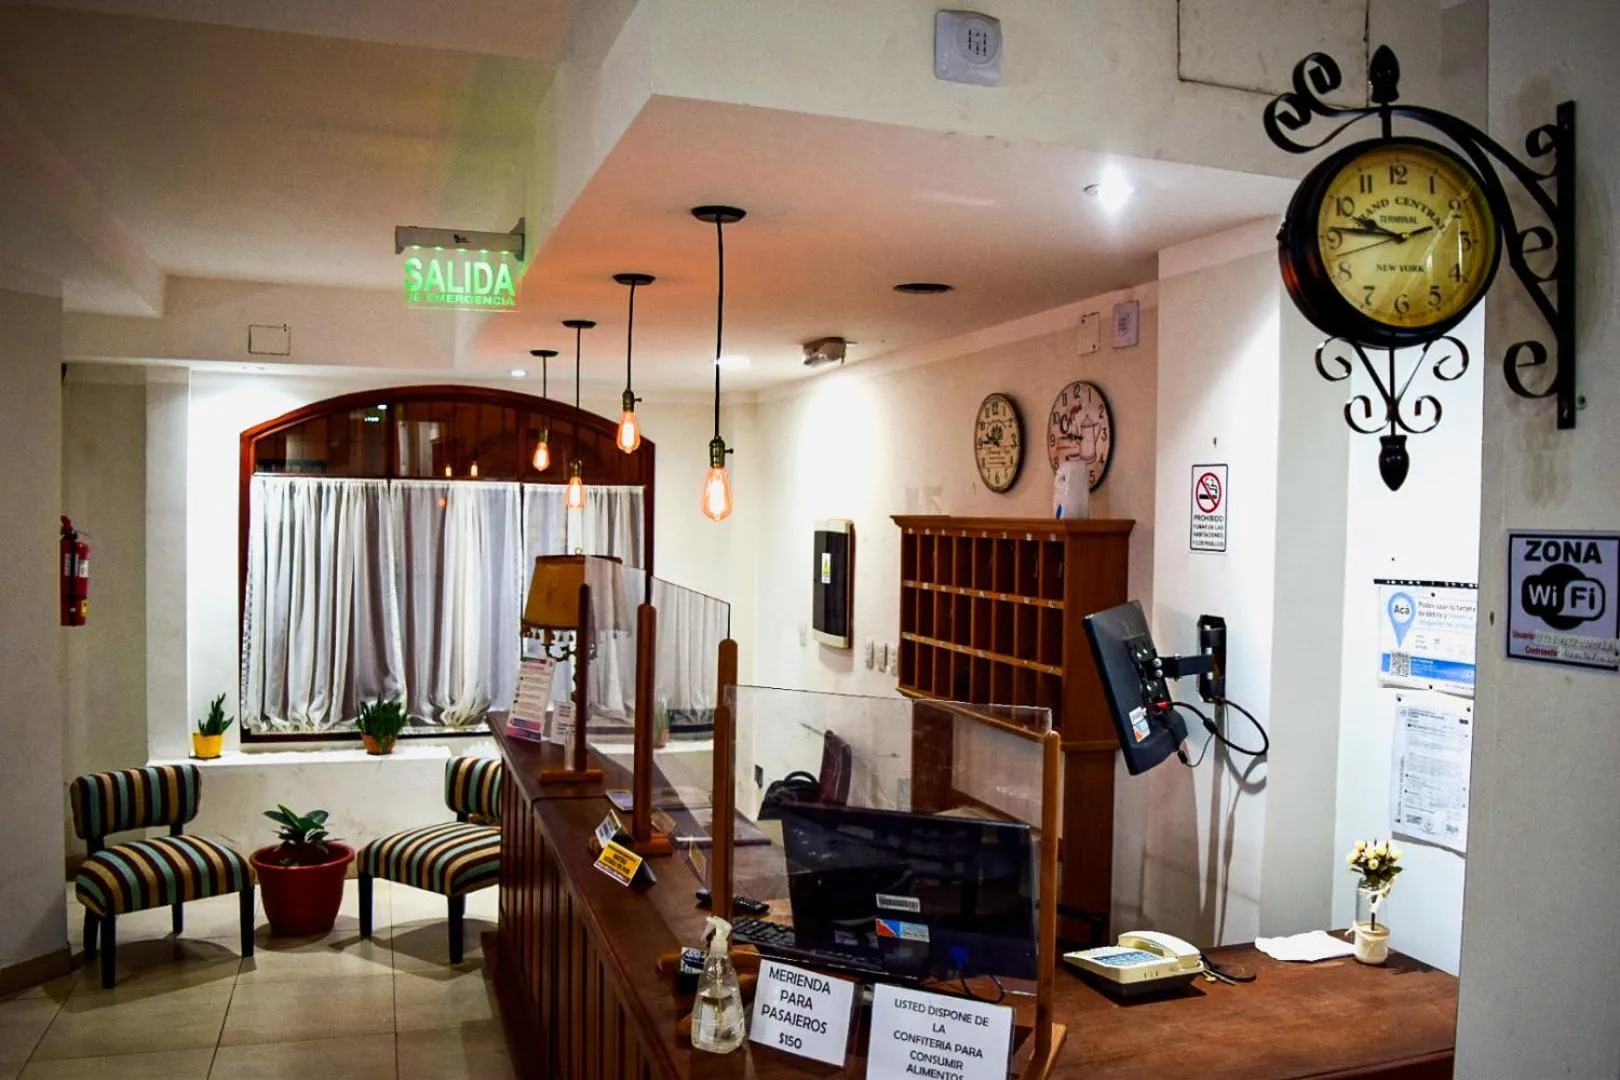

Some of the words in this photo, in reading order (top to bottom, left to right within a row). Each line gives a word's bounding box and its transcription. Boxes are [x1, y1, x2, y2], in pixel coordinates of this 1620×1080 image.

[1359, 174, 1372, 194] 11
[1388, 164, 1408, 185] 12
[1429, 175, 1436, 194] 1
[1336, 196, 1355, 217] 10
[1379, 214, 1418, 225] TERMINAL
[1327, 229, 1343, 249] 9
[1460, 231, 1472, 251] 3
[404, 257, 516, 296] SALIDA
[1338, 261, 1352, 282] 8
[1376, 264, 1396, 273] NEW
[1399, 264, 1425, 273] YORK
[1448, 264, 1462, 283] 4
[1363, 286, 1376, 306] 7
[1394, 294, 1410, 314] 6
[1428, 286, 1442, 306] 5
[1524, 540, 1602, 564] ZONA
[768, 966, 831, 996] MERIENDA
[780, 989, 813, 1011] PARA
[761, 1004, 828, 1034] PASAJEROS
[894, 998, 926, 1017] USTED
[927, 1004, 973, 1024] DISPONE
[974, 1015, 990, 1028] DE
[932, 1022, 946, 1035] LA
[778, 1032, 802, 1050] $150
[893, 1029, 953, 1052] CONFITERIA
[954, 1043, 984, 1060] PARA
[909, 1050, 964, 1071] CONSUMIR
